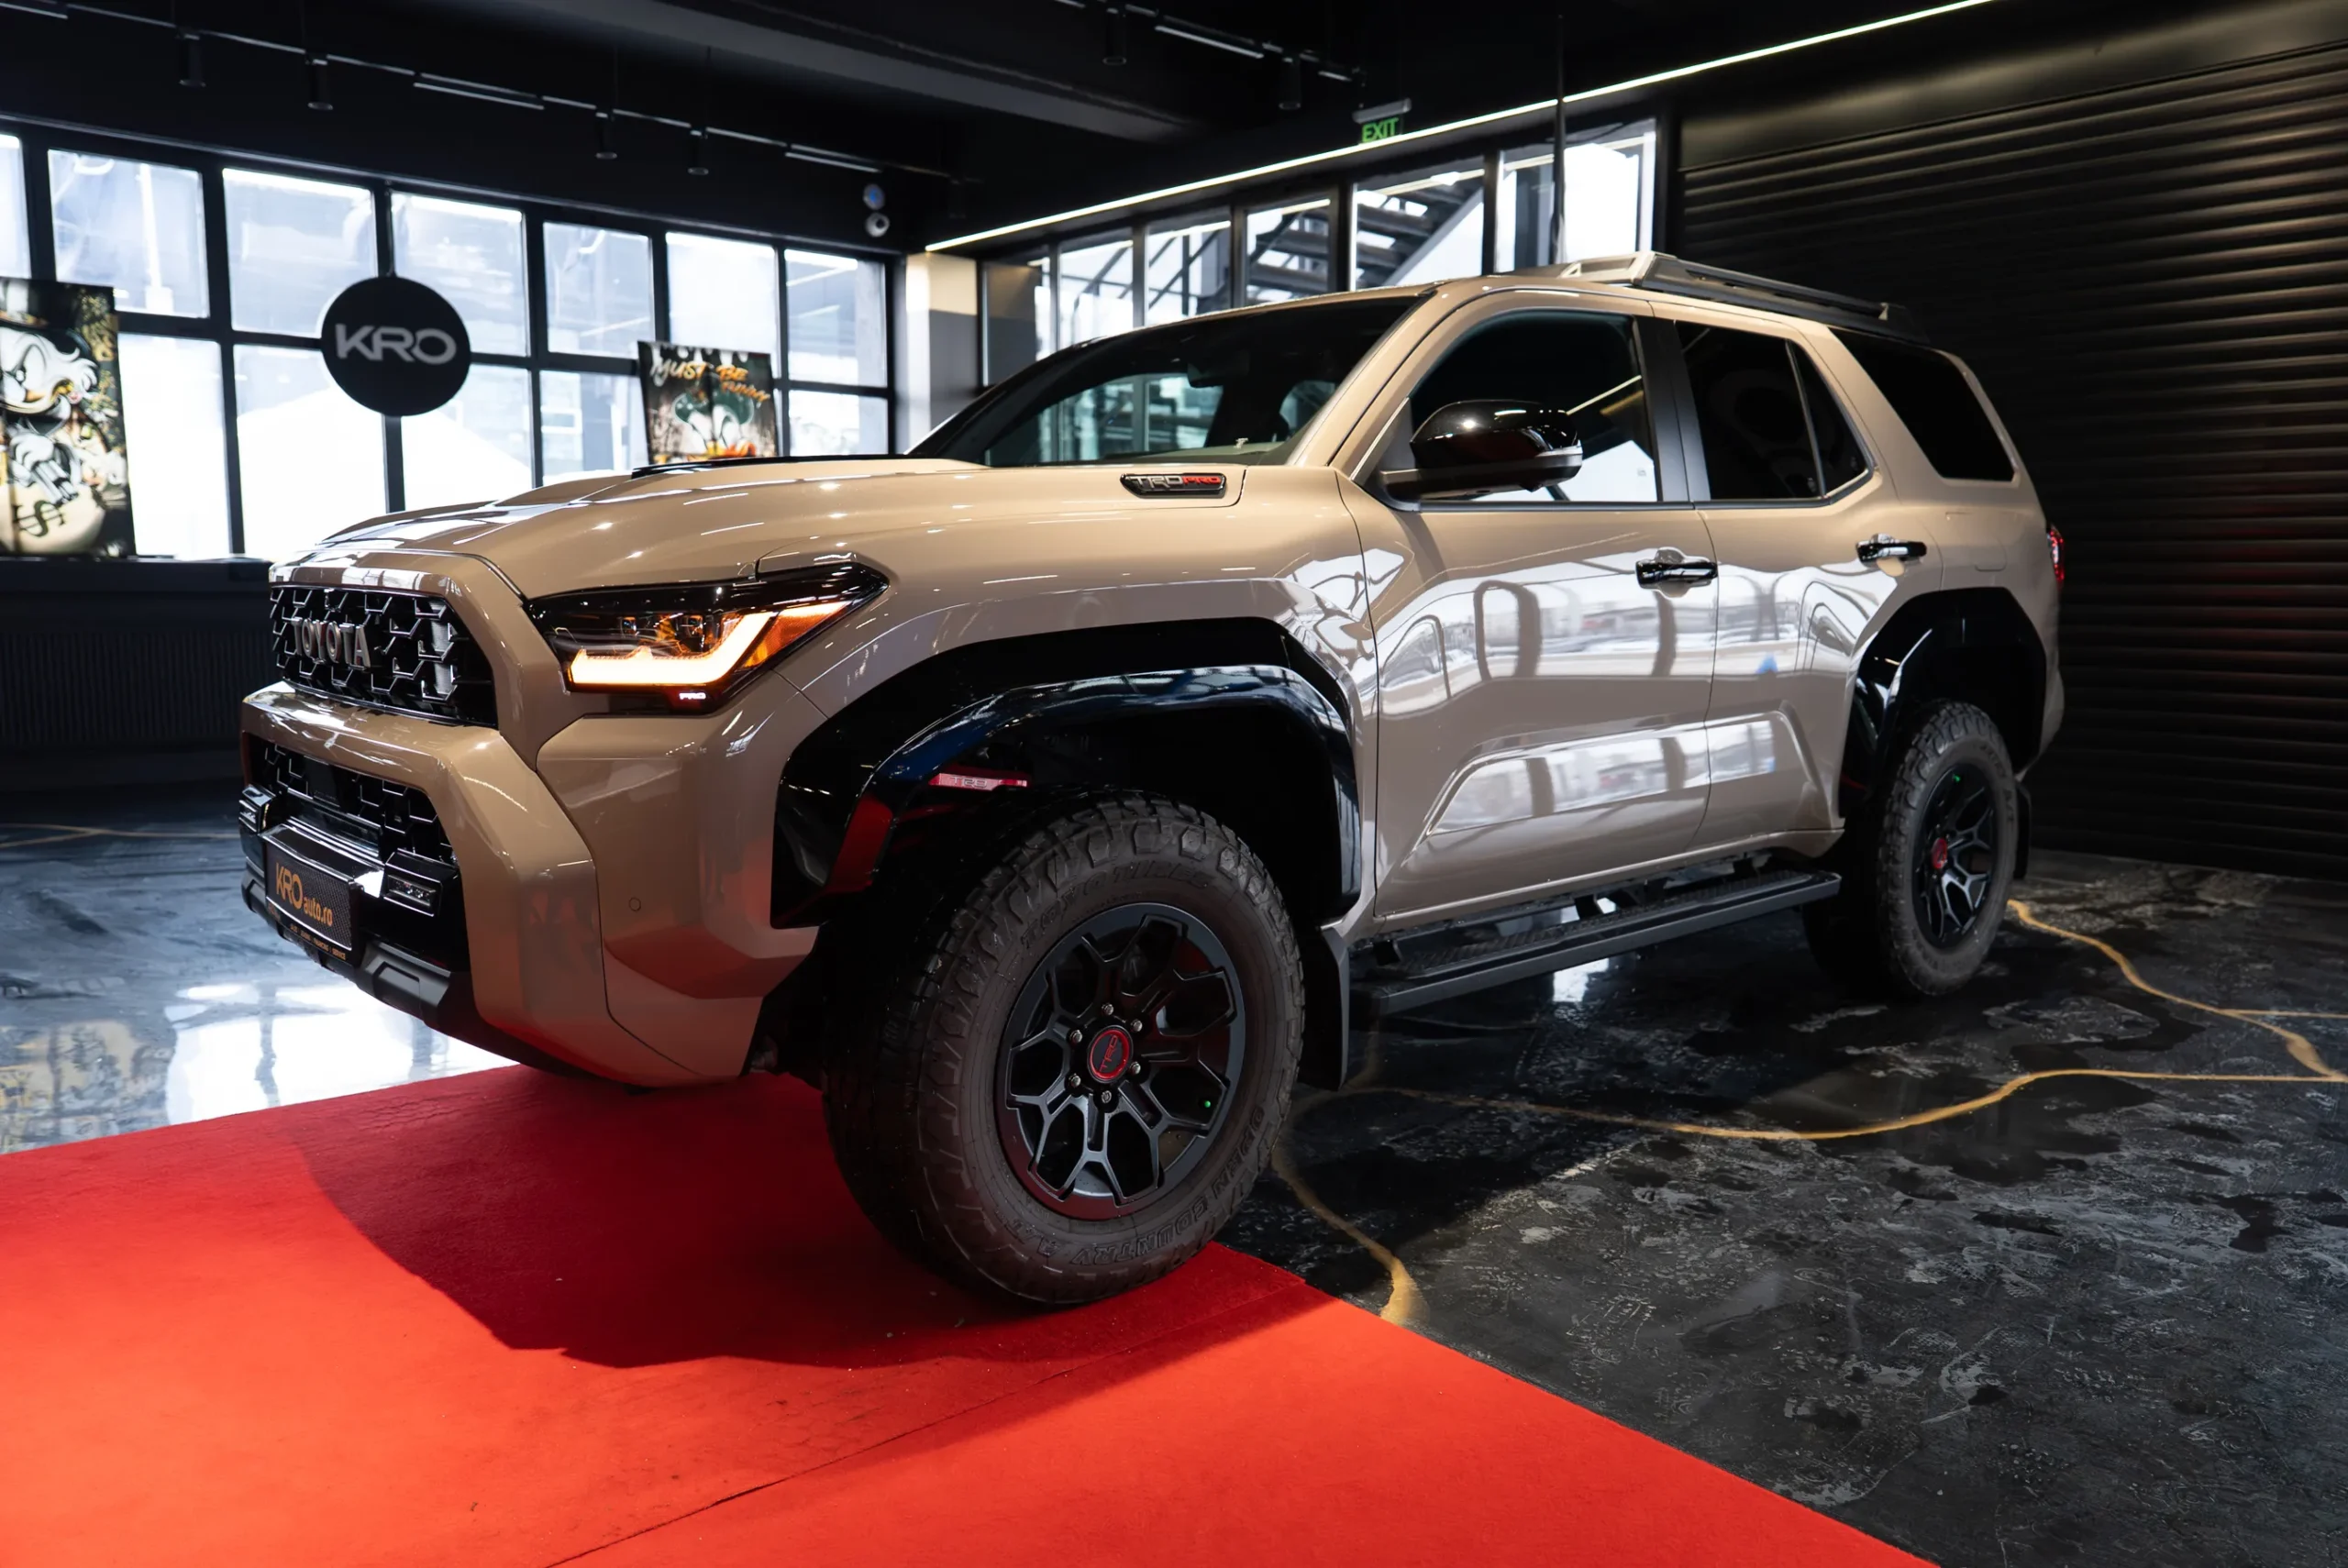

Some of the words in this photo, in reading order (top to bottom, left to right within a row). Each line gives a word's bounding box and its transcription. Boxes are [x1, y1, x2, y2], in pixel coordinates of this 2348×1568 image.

[1362, 116, 1399, 143] EXIT
[335, 324, 457, 365] KRO
[1125, 476, 1182, 488] TRD
[1182, 475, 1222, 485] PRO
[291, 616, 371, 668] TOYOTA
[950, 776, 988, 789] TRD
[1098, 1033, 1118, 1073] TRD
[1212, 1104, 1266, 1198] OPEN
[1070, 1196, 1209, 1266] COUNTRY
